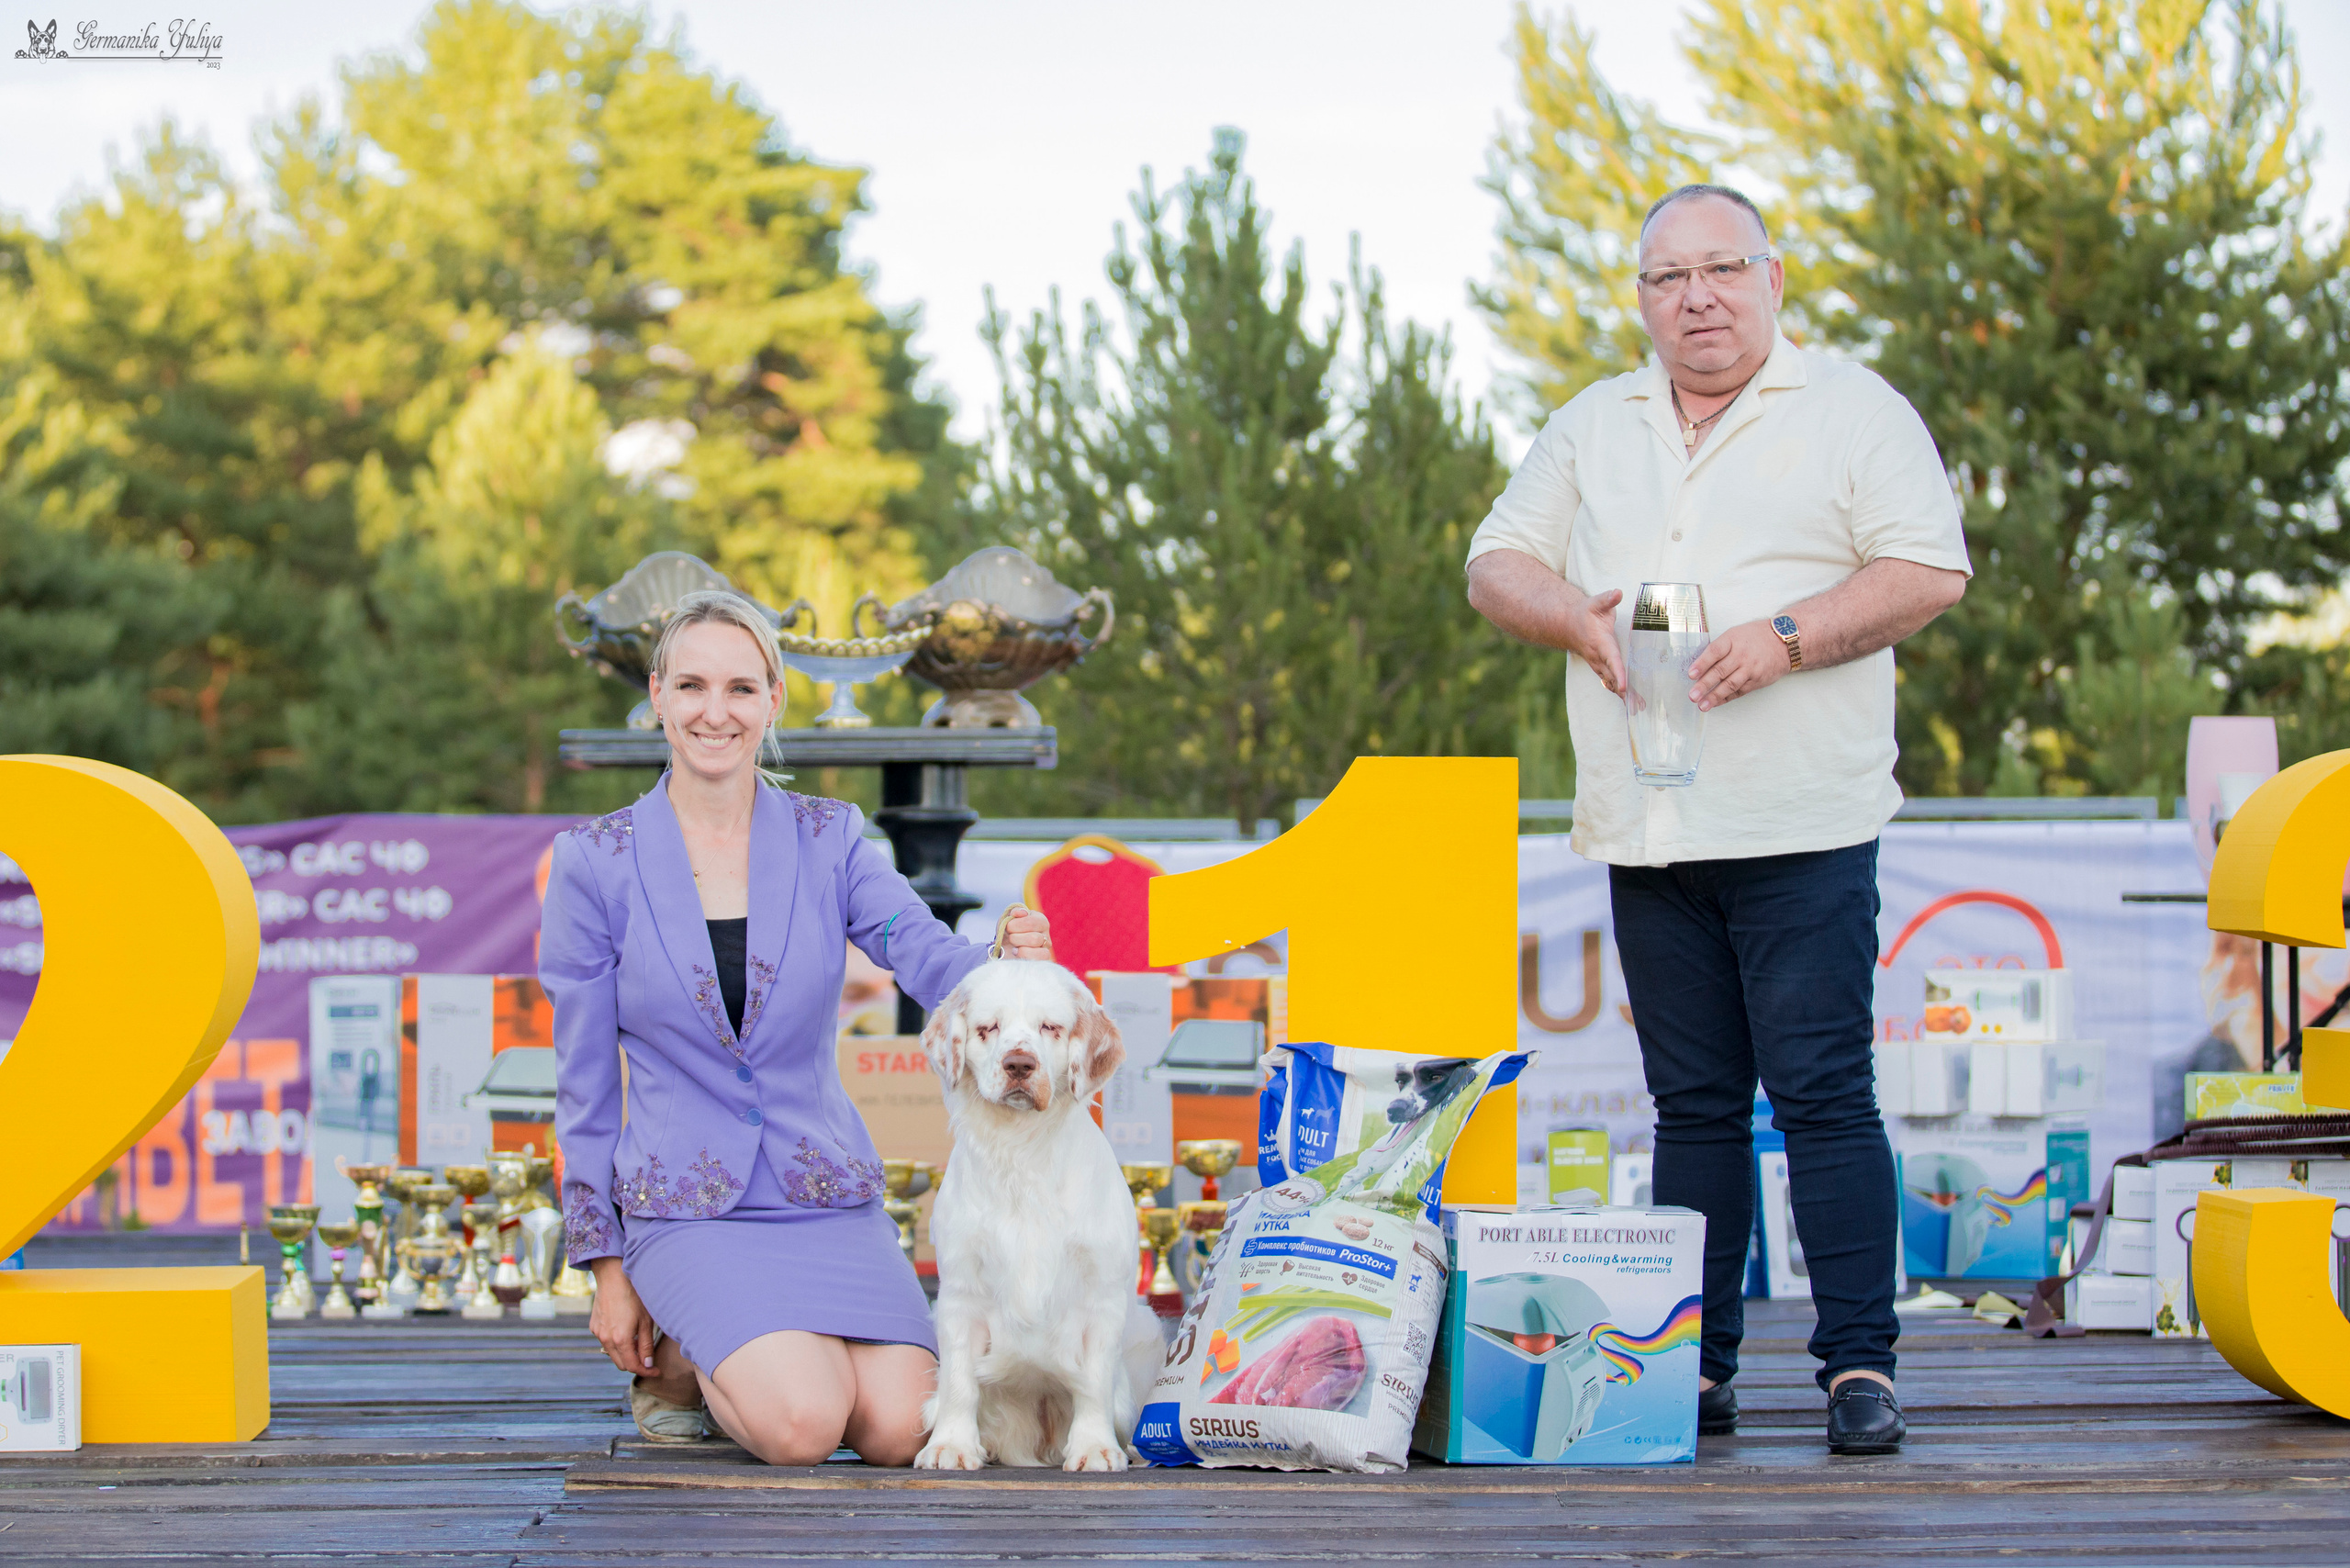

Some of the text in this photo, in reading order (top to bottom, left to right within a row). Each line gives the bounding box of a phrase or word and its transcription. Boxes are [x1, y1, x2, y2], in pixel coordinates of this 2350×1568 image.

[856, 1051, 929, 1075] STAR
[201, 1108, 312, 1159] ЗАВО
[1262, 1220, 1290, 1231] УТКА
[1372, 1238, 1383, 1249] 12
[1572, 1228, 1677, 1245] ELECTRONIC
[1258, 1240, 1392, 1271] Комплекс пробиотиков ProStor+
[1532, 1251, 1673, 1266] 7.5L Cooling&warming
[1617, 1265, 1673, 1275] refrigerators
[56, 1350, 67, 1446] PET GROOMING DRYER
[1140, 1422, 1172, 1439] ADULT
[1190, 1417, 1259, 1439] SIRIUS
[1194, 1439, 1250, 1450] ИНДЕЙКА
